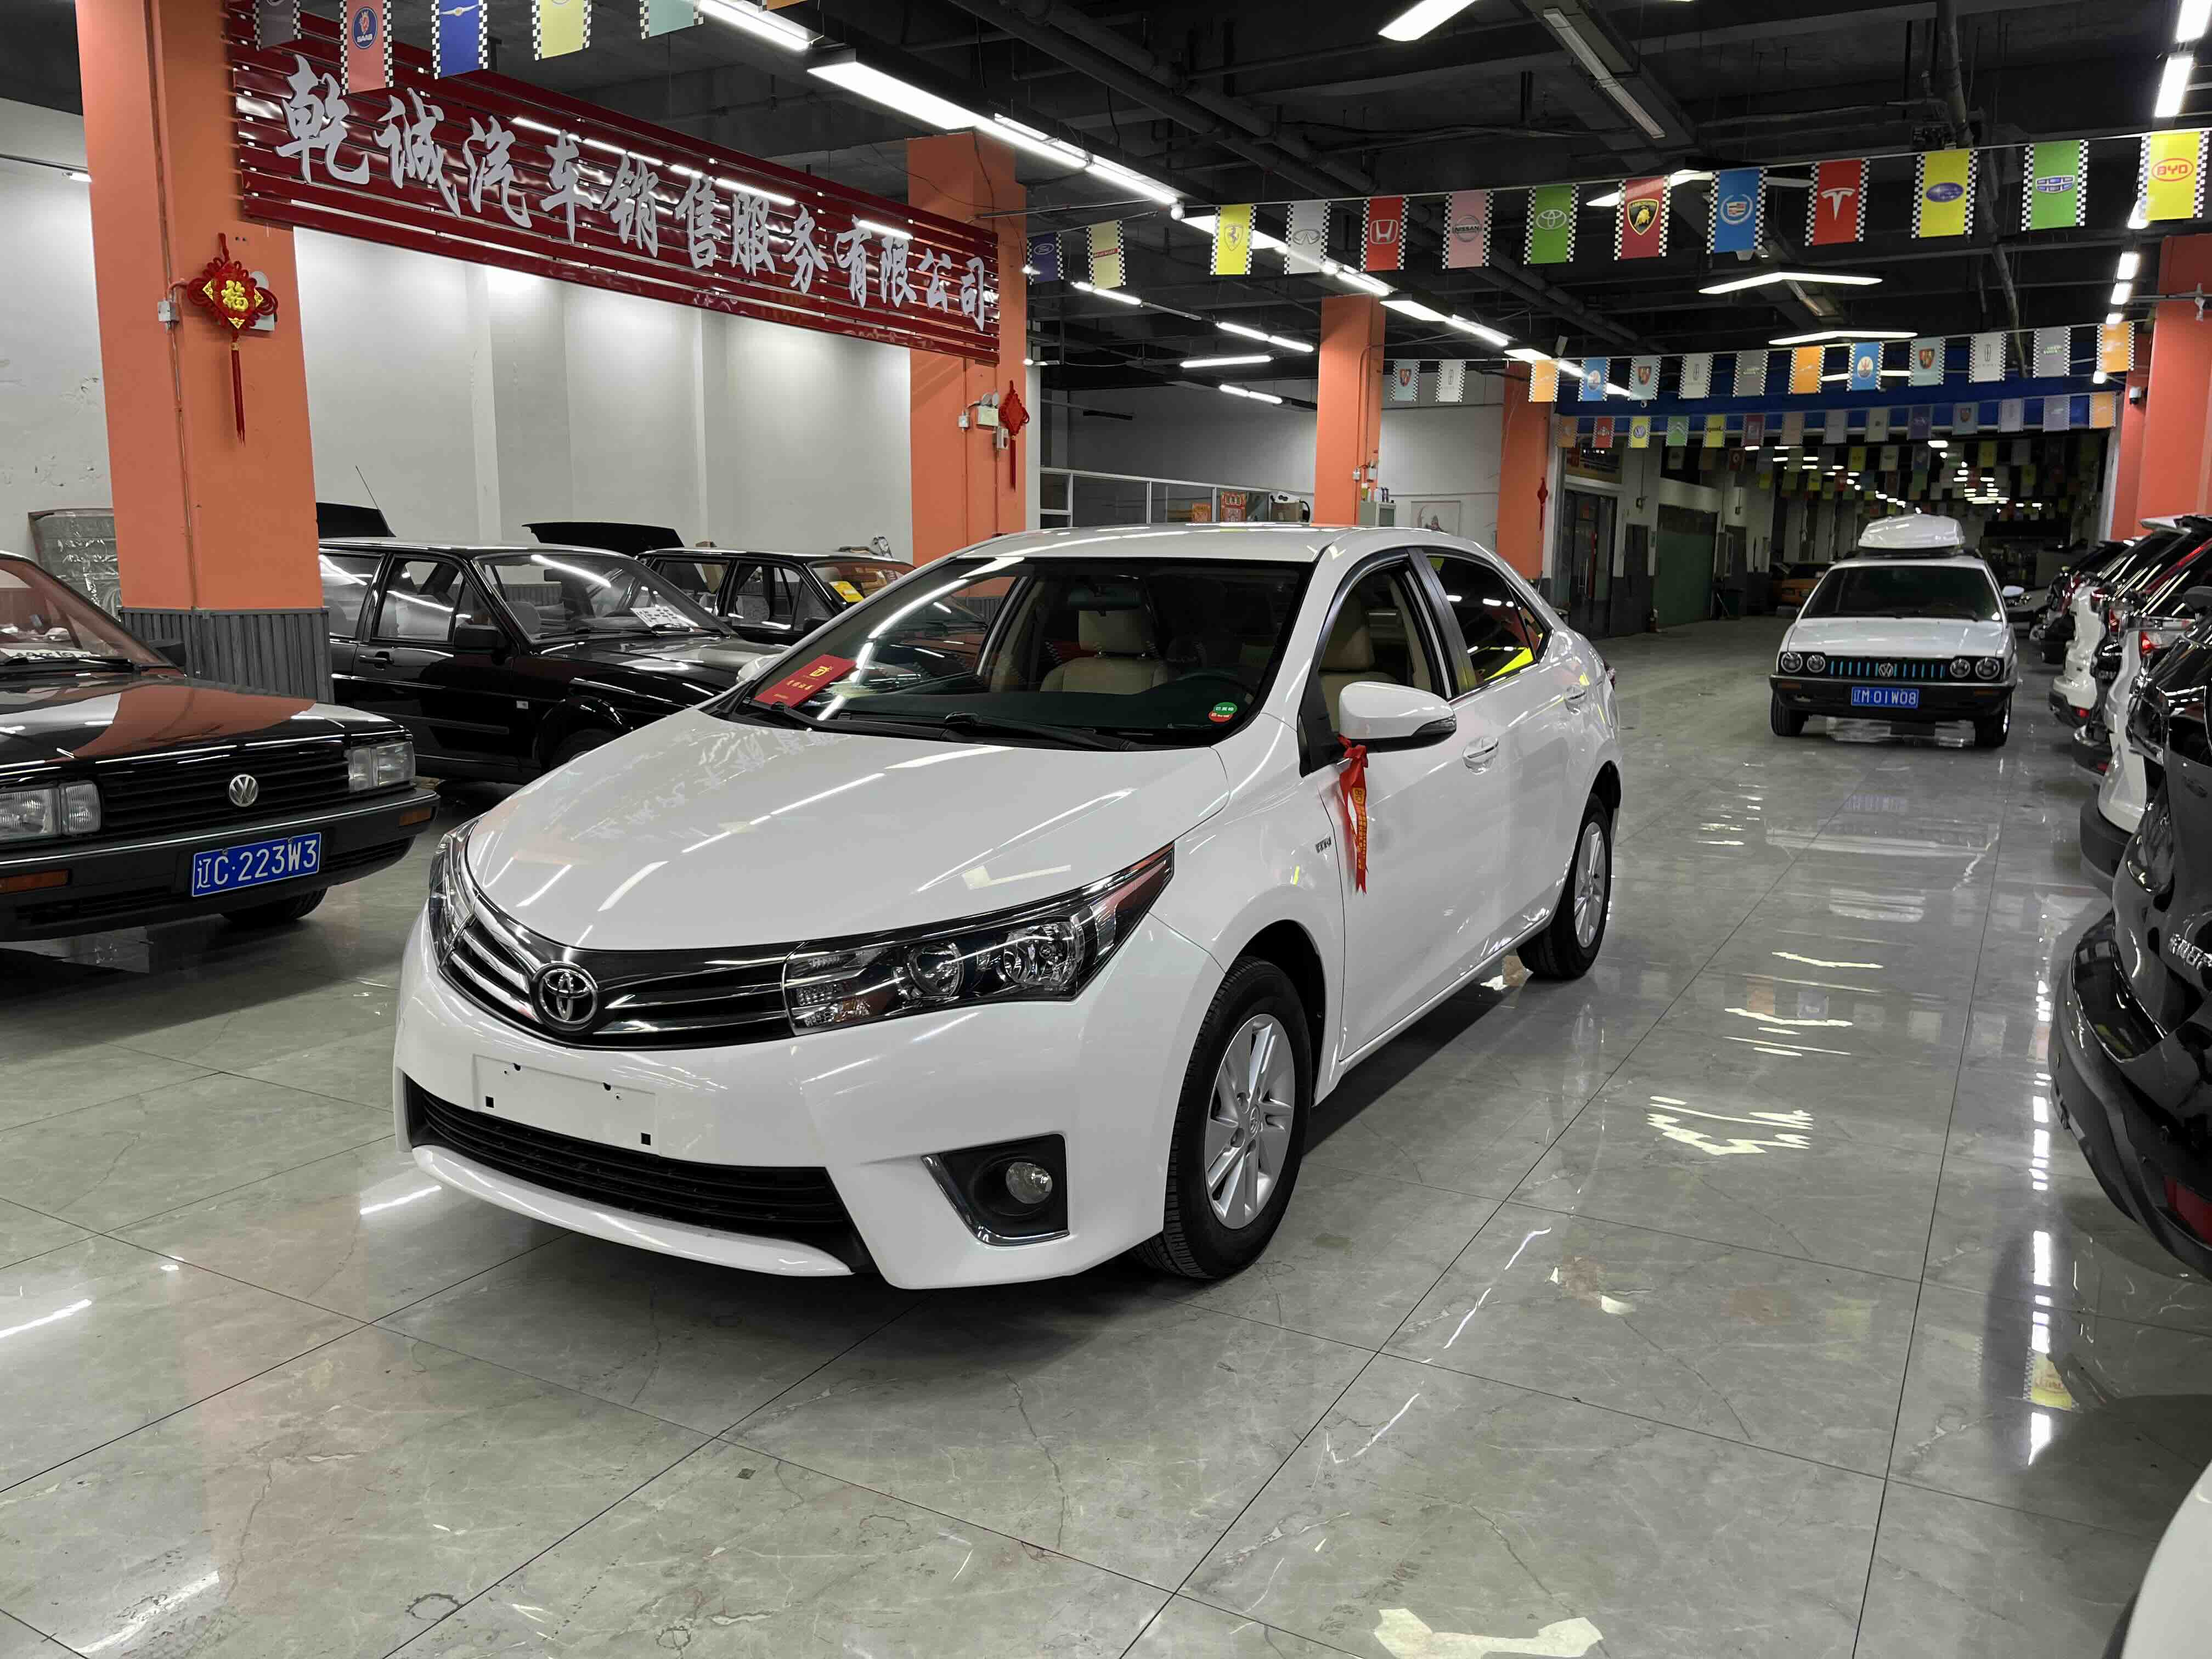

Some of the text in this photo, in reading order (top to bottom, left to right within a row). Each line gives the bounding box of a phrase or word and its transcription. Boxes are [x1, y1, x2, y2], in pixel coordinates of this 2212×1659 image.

[357, 33, 373, 43] SAAB
[2157, 164, 2188, 176] BYD
[275, 54, 985, 331] 乾诚汽车销售服务有限公司
